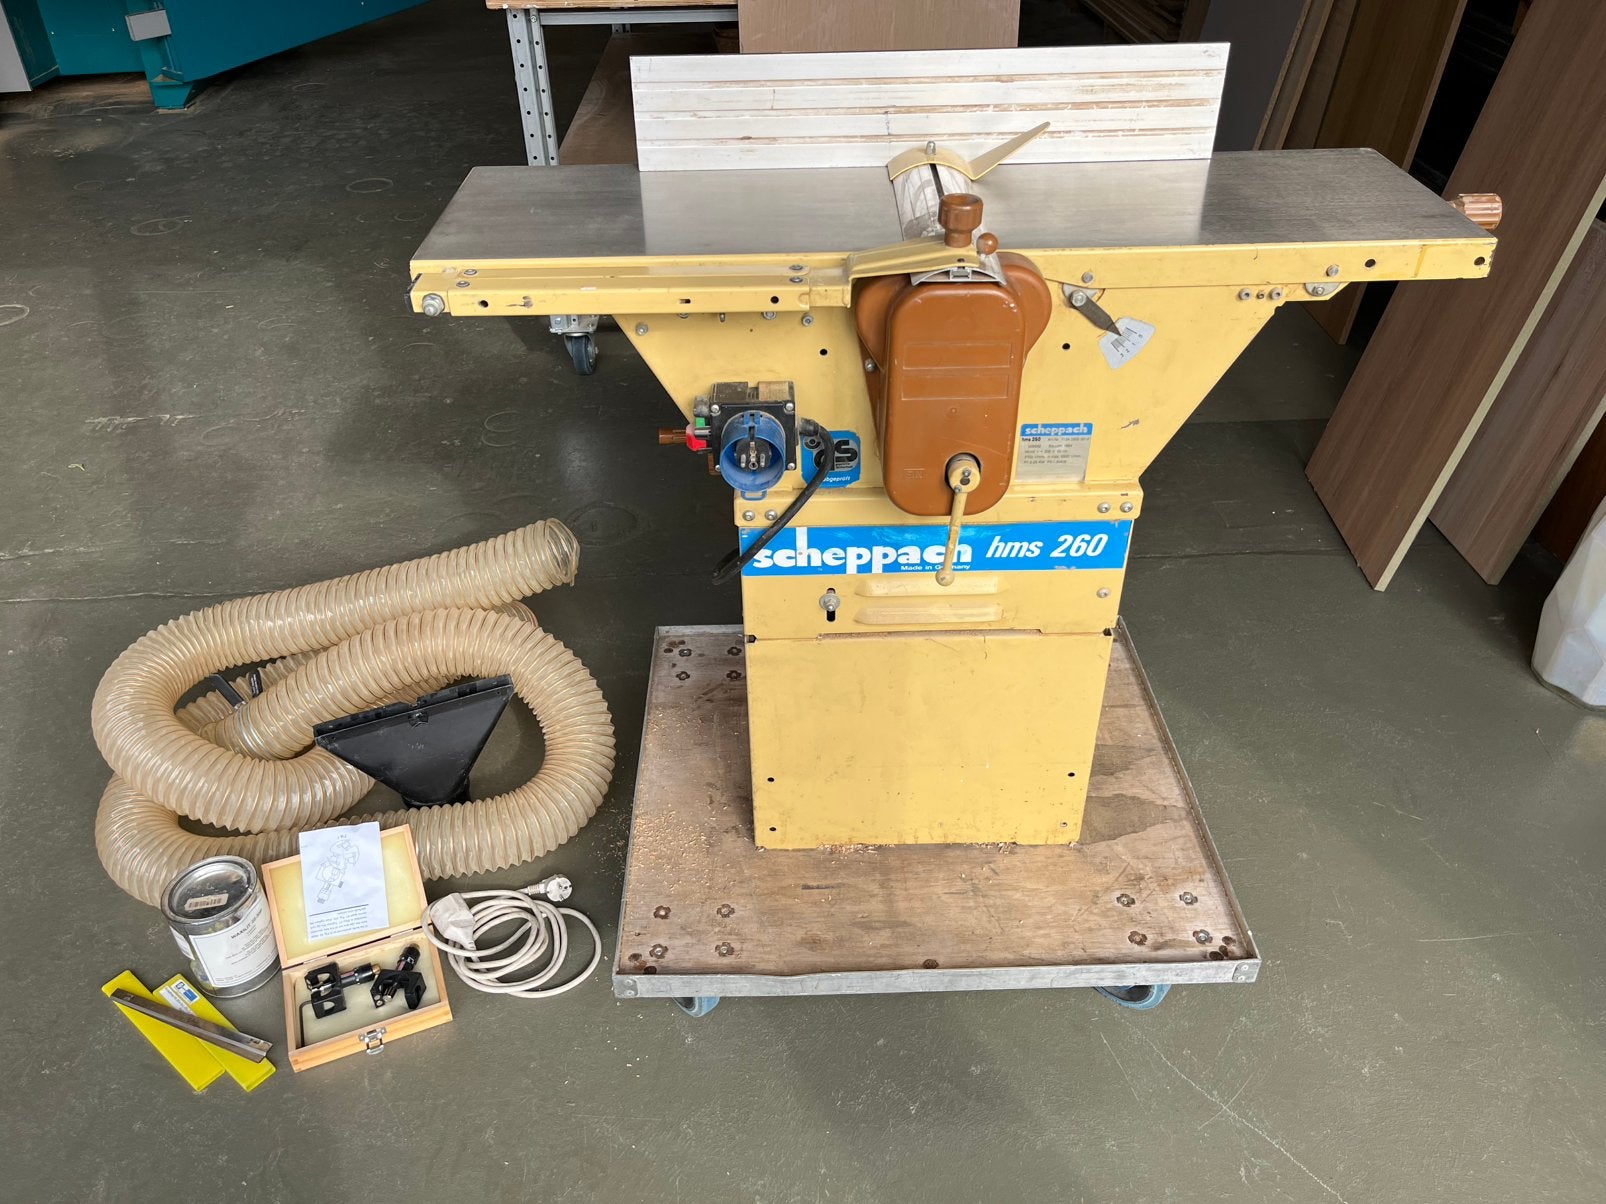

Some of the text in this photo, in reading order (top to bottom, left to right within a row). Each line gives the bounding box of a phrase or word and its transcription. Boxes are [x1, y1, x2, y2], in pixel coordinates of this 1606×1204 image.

[1025, 423, 1088, 436] scheppach
[753, 527, 972, 574] scheppach
[986, 533, 1109, 558] hms 260
